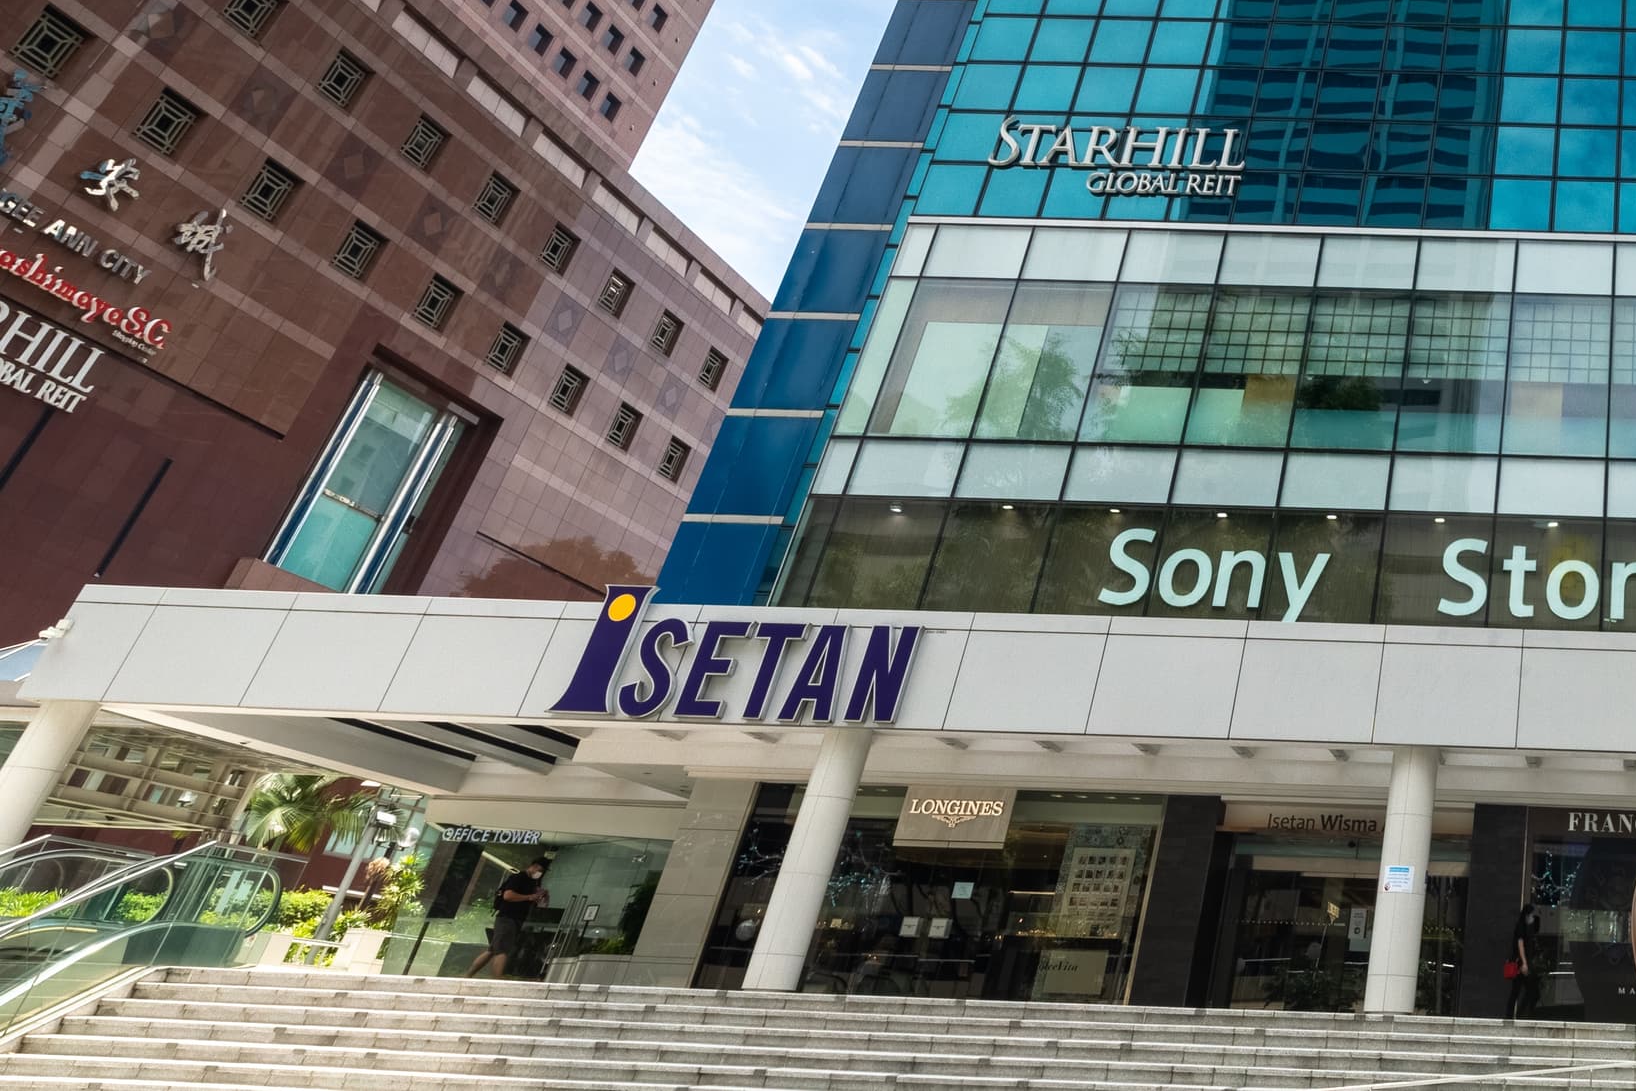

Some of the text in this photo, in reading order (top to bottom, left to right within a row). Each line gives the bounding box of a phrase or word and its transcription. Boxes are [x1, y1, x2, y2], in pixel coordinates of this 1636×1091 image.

[987, 114, 1246, 171] STARHILL
[1086, 172, 1242, 196] GLOBAL REIT
[0, 189, 152, 285] GEE ANN CITY
[0, 300, 104, 393] HILL
[0, 358, 88, 413] BAL REIT
[1097, 527, 1331, 623] Sony
[910, 799, 1004, 816] LONGINES
[1267, 813, 1315, 830] Isetan
[1320, 814, 1377, 832] Wisma
[442, 827, 542, 844] OFFICE TOWER
